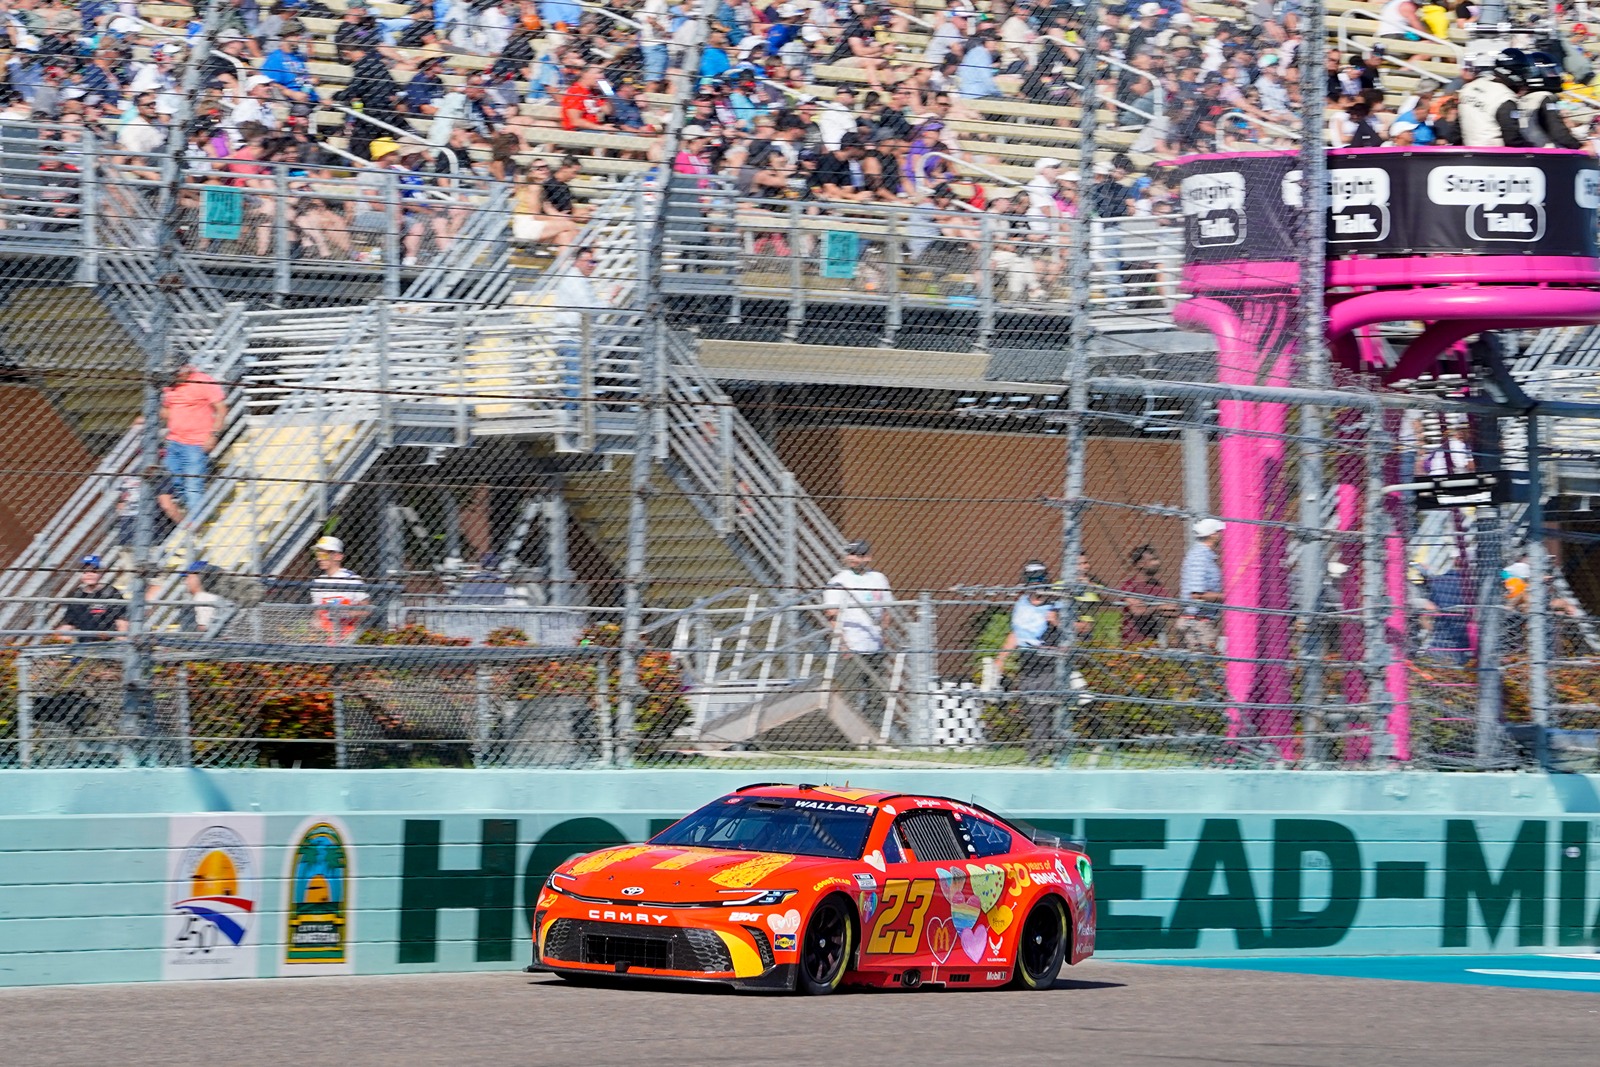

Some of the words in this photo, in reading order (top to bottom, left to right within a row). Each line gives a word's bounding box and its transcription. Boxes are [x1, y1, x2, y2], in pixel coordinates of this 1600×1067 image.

[1445, 174, 1532, 198] Straight
[1198, 216, 1236, 238] Talk
[1331, 213, 1378, 234] Talk
[1484, 212, 1534, 233] Talk
[795, 800, 867, 814] WALLACE
[813, 877, 851, 892] GOODYEAR
[1002, 862, 1031, 897] 50
[1026, 861, 1044, 872] years
[1044, 859, 1051, 870] of
[1029, 872, 1062, 886] RMHC
[588, 909, 668, 924] CAMRY
[866, 879, 936, 954] 23
